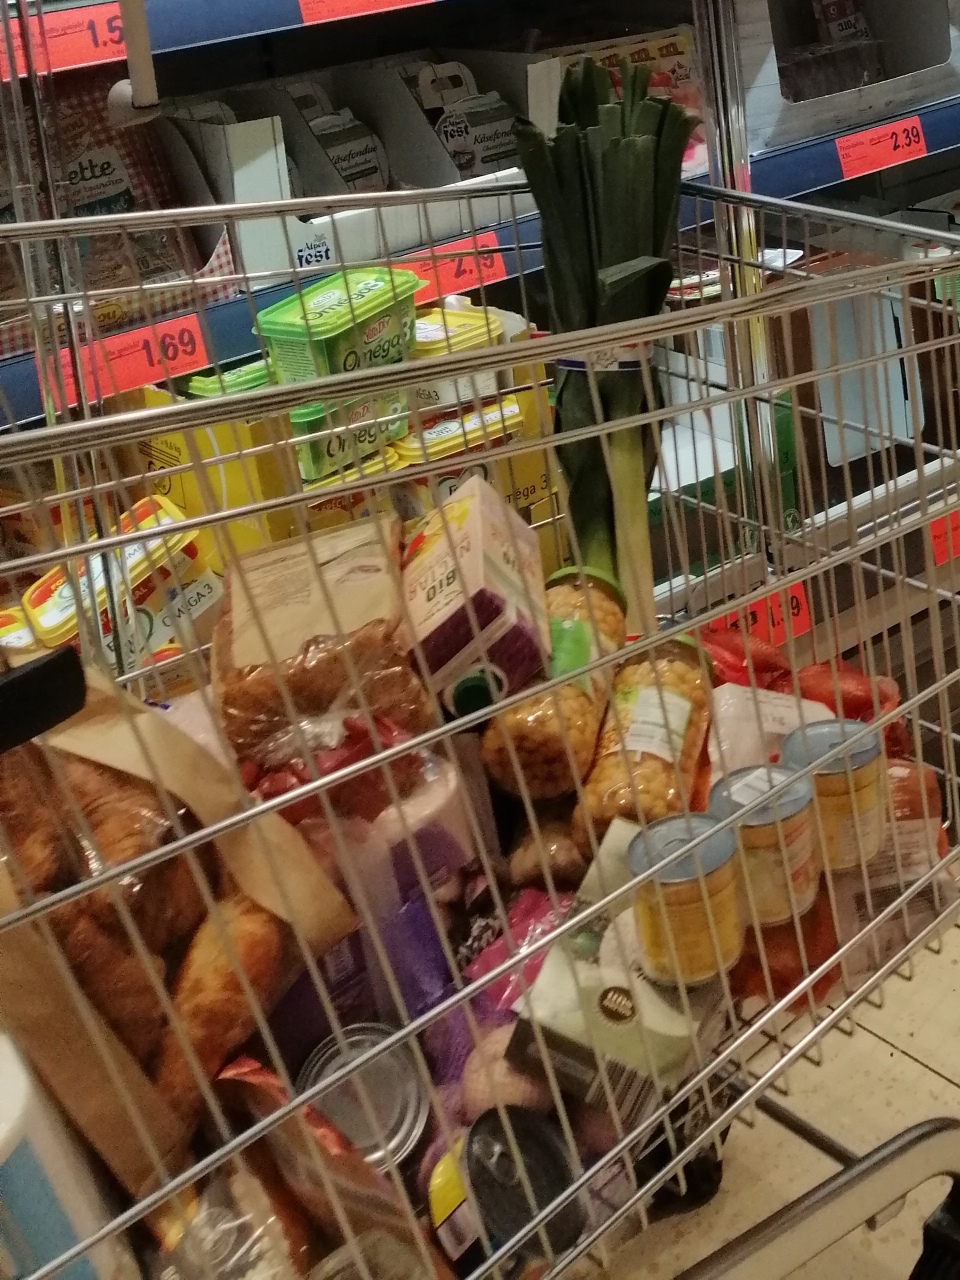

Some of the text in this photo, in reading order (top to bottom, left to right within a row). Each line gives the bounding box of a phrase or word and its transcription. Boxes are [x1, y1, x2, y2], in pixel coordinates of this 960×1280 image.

[87, 14, 124, 49] 1.5
[442, 122, 470, 143] fest
[473, 129, 517, 145] Käsefond
[890, 125, 921, 152] 2.39
[69, 158, 117, 186] ette
[296, 245, 331, 267] fest
[303, 239, 327, 252] Alpen
[450, 242, 496, 279] 2.9
[300, 286, 373, 321] Oméga
[141, 327, 196, 368] 1.69
[343, 334, 401, 372] Oméga
[540, 473, 549, 490] 3
[770, 595, 801, 629] 1.9
